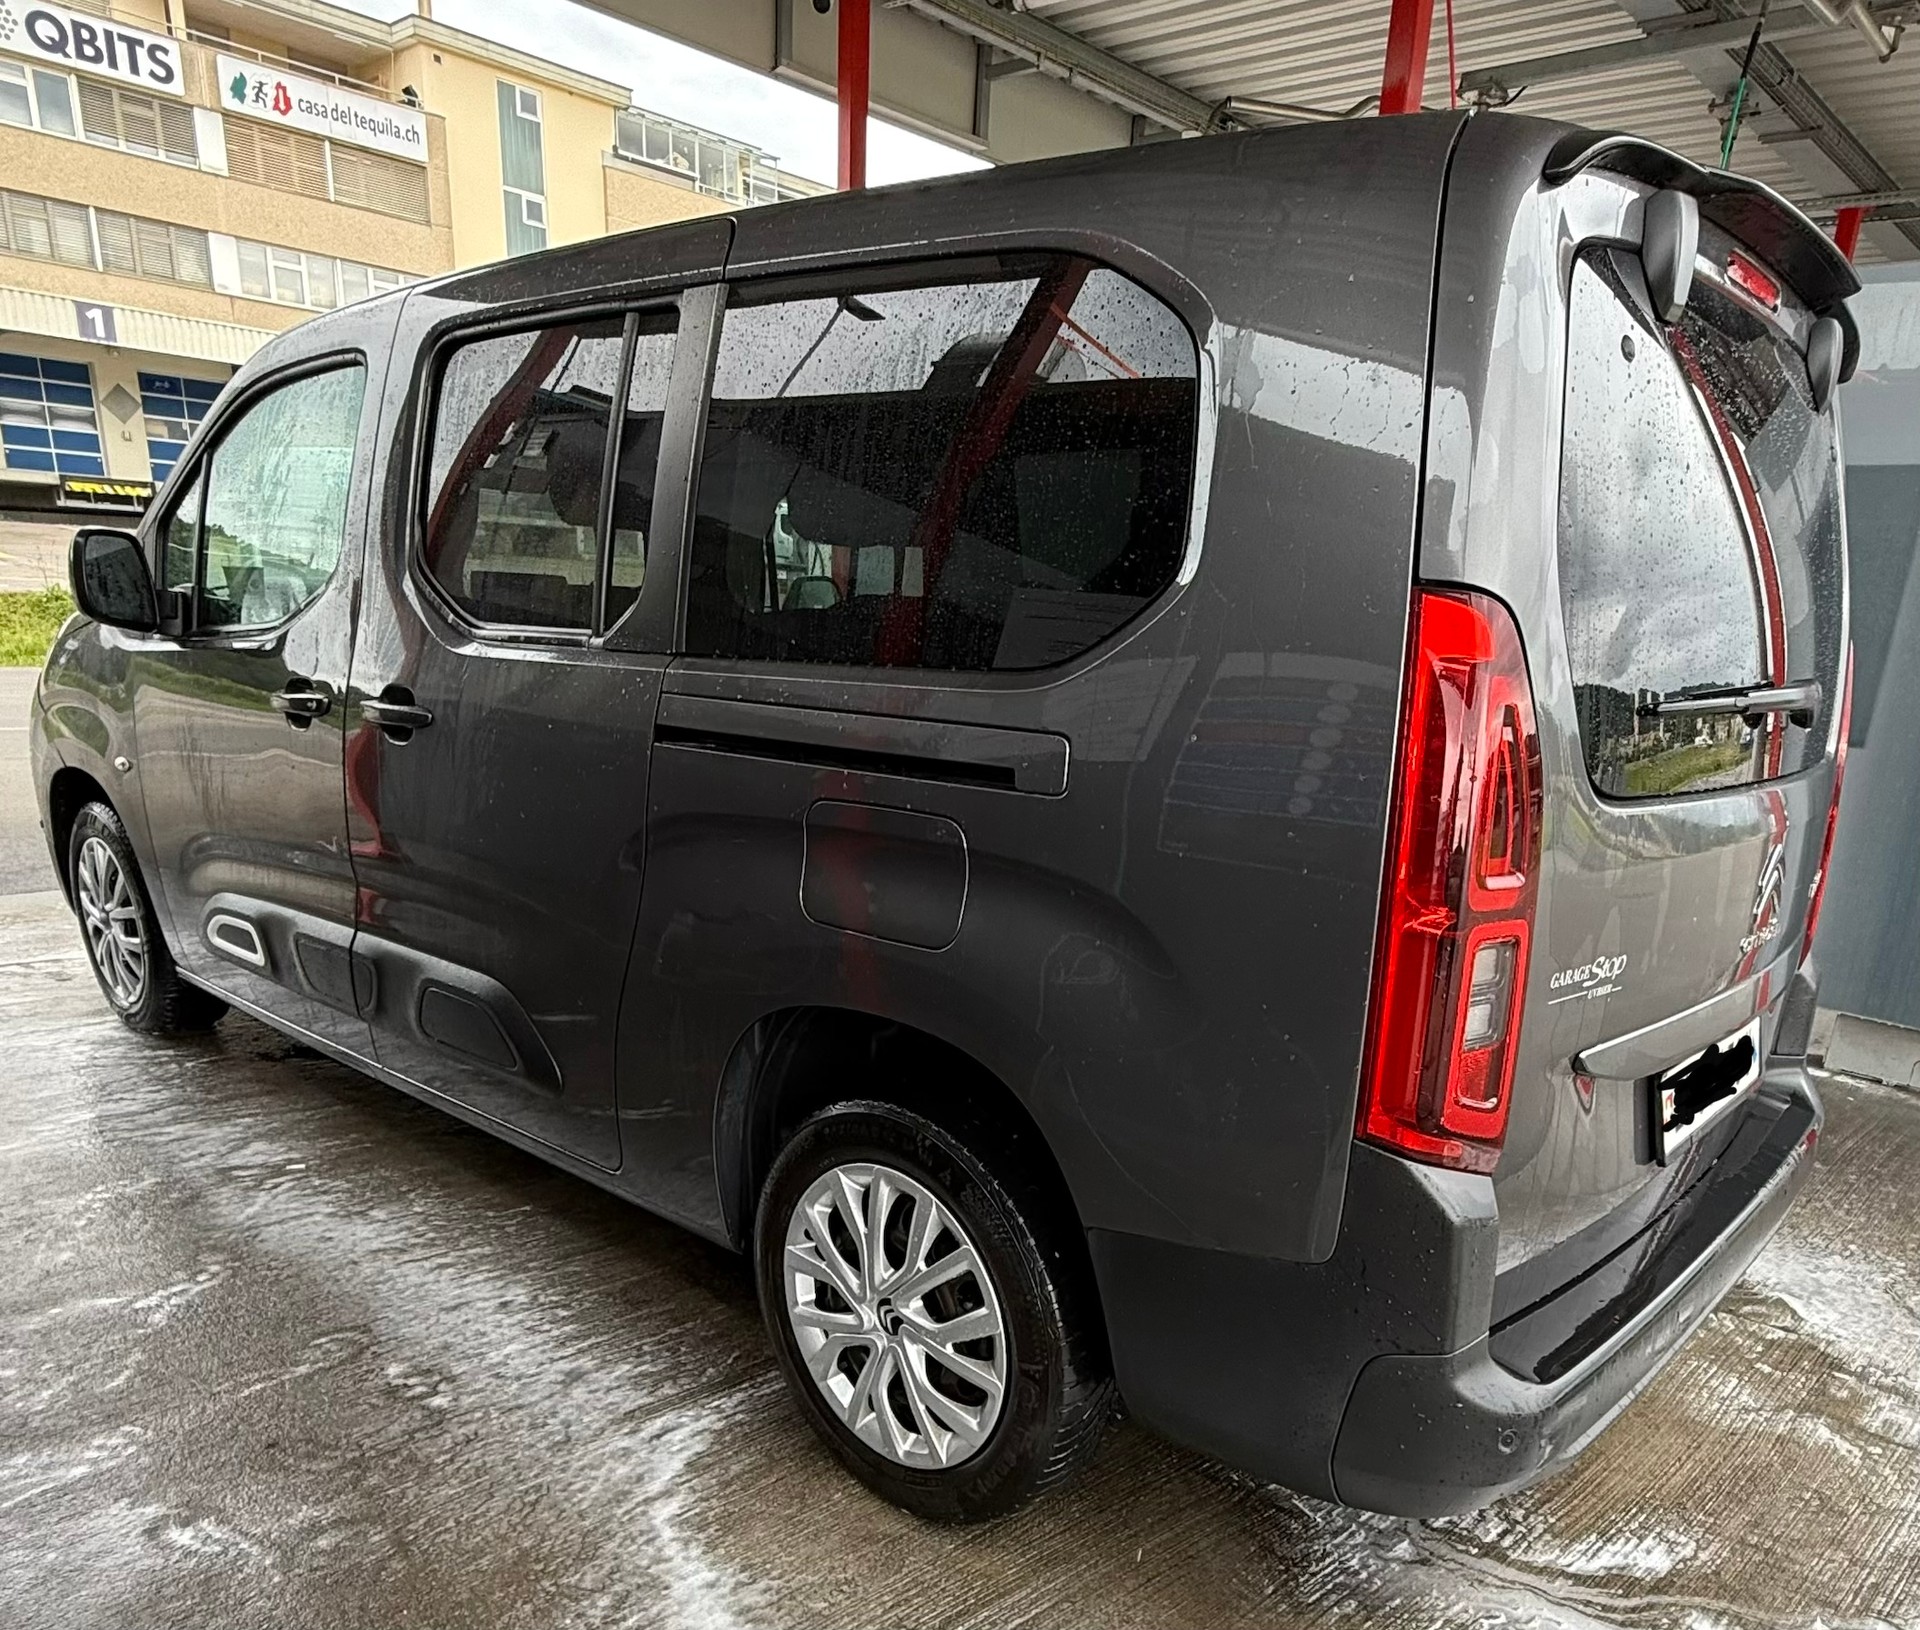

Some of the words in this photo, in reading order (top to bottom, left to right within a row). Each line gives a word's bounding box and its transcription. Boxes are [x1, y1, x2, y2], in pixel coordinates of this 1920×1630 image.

[24, 9, 175, 85] QBITS
[84, 308, 106, 339] 1
[1549, 964, 1592, 989] GARAGE
